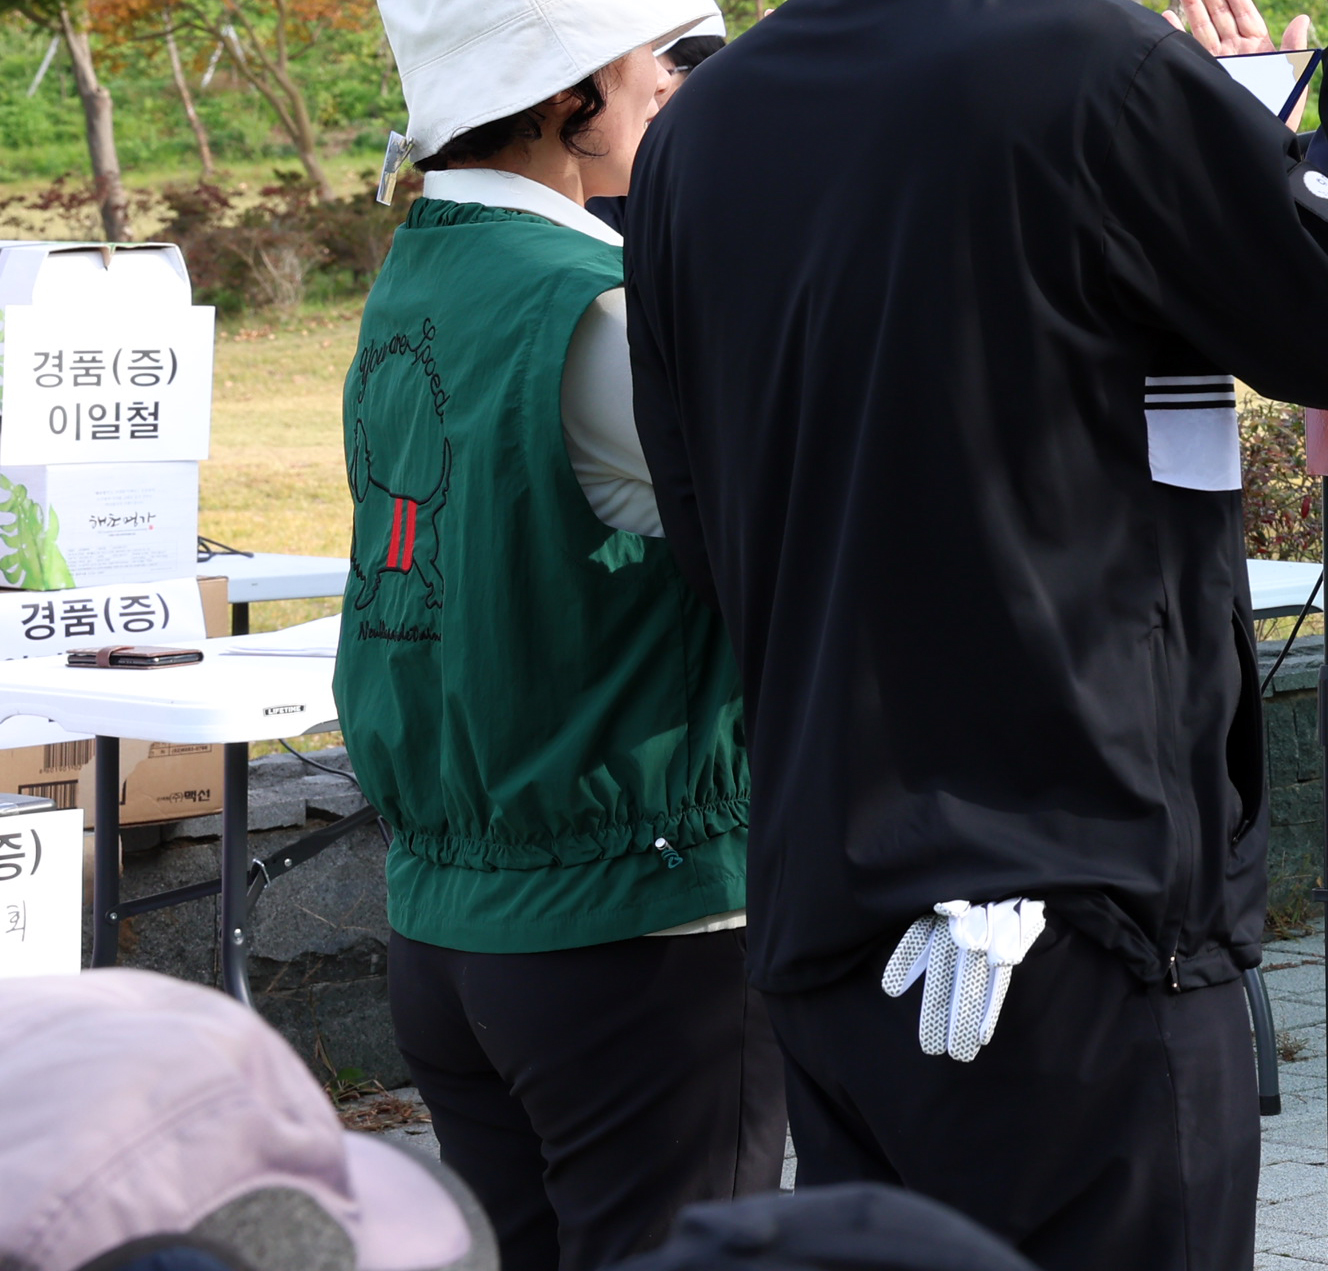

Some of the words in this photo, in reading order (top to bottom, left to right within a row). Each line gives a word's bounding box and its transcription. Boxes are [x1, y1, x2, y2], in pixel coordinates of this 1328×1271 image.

[32, 347, 179, 388] 경품(증)
[48, 400, 161, 441] 이일철
[20, 593, 171, 641] 경품(증)
